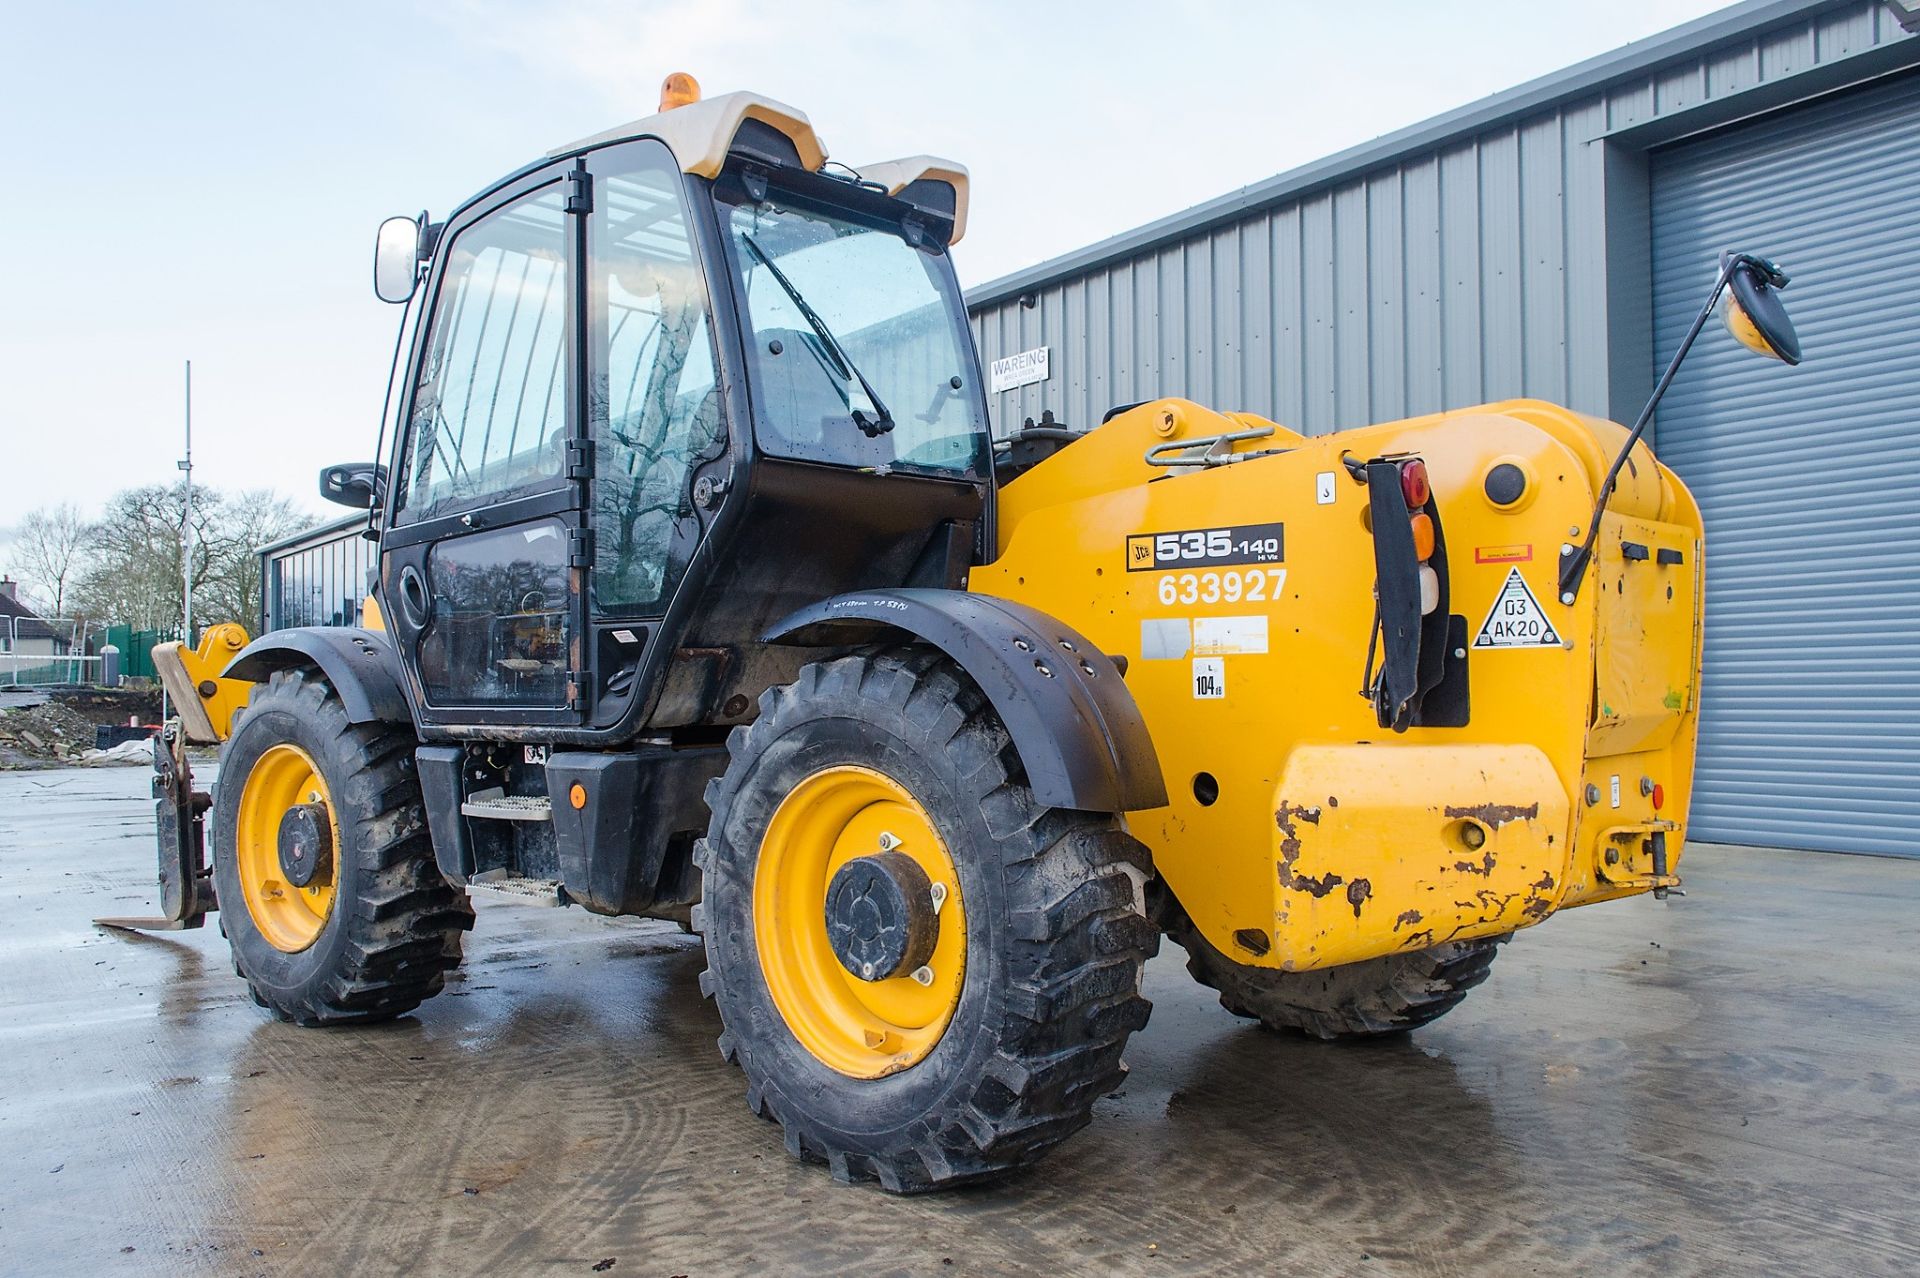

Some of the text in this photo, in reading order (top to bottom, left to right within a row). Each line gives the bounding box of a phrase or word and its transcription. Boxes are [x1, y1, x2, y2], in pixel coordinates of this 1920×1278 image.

[994, 349, 1046, 376] WAREING
[1134, 545, 1151, 561] JCB
[1158, 568, 1287, 605] 633927
[1505, 599, 1526, 615] 03
[1494, 620, 1539, 637] AK20
[1196, 676, 1215, 695] 104
